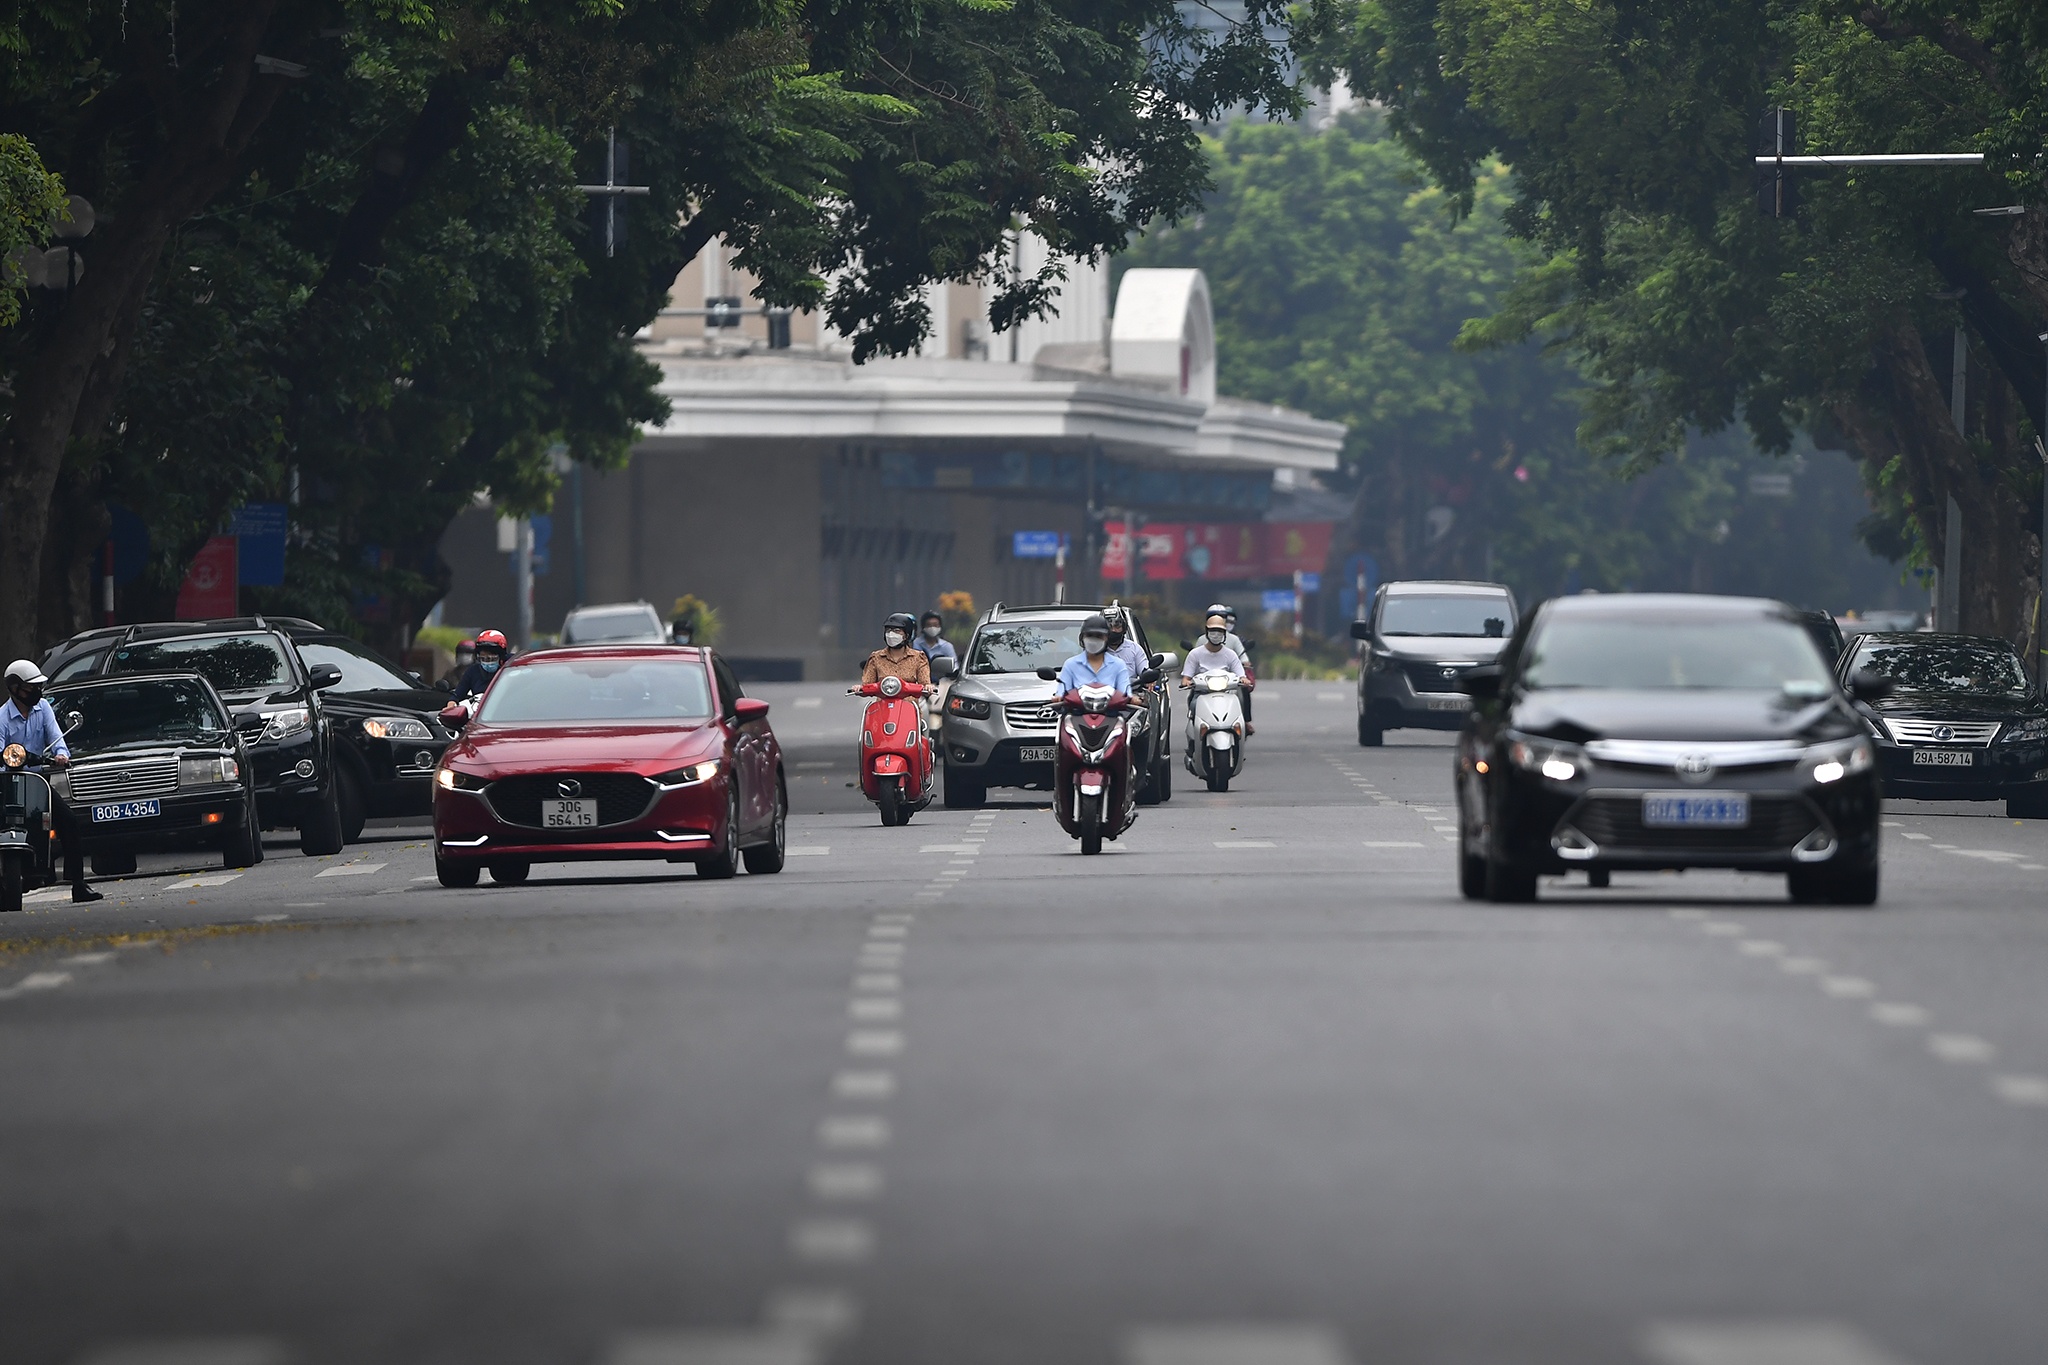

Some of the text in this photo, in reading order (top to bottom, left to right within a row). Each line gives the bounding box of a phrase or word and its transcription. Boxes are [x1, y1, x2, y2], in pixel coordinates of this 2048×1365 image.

[1915, 752, 1971, 765] 29A-587.14
[96, 802, 156, 820] 80B-4354
[558, 801, 582, 813] 30G
[548, 813, 592, 826] 564.15
